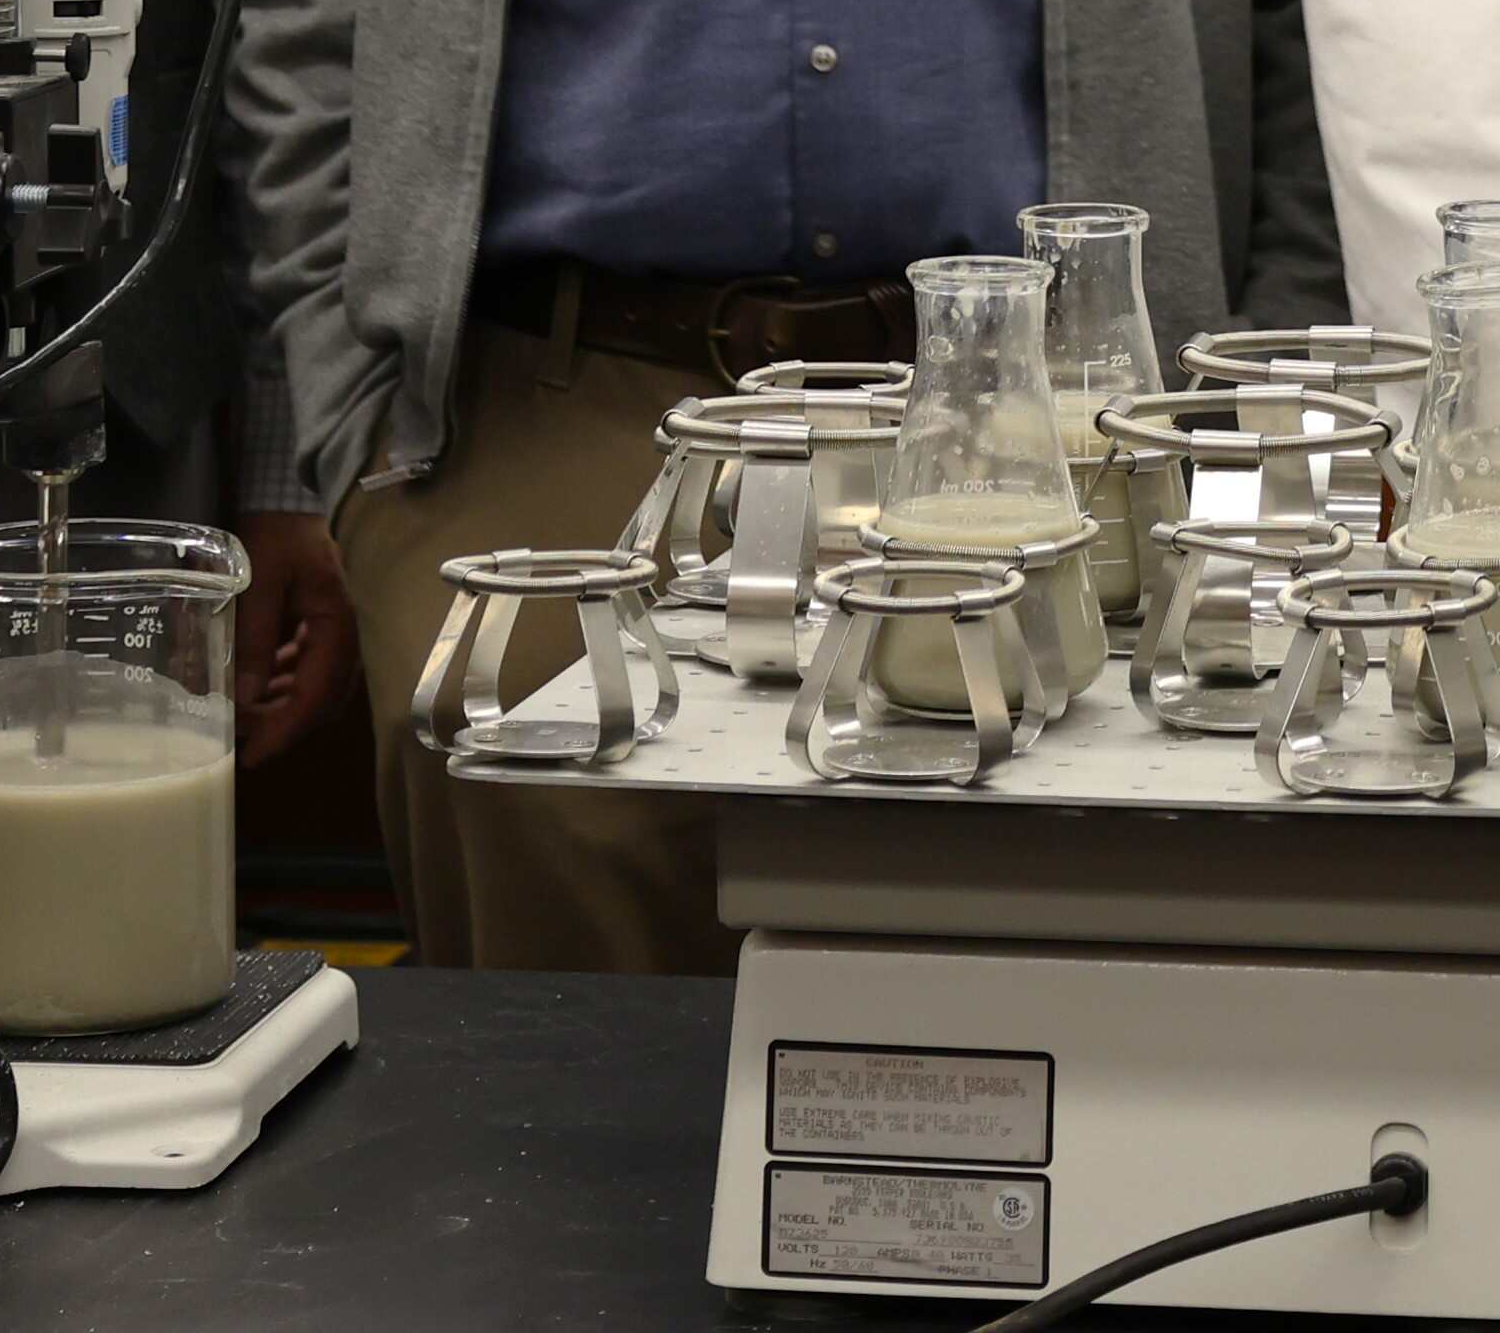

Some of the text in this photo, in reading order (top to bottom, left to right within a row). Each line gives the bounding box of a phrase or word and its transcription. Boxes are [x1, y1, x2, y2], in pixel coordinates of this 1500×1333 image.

[1110, 353, 1133, 368] 225
[778, 1214, 819, 1225] MODEL
[909, 1220, 958, 1231] SERIAL
[777, 1243, 819, 1254] VOLTS
[951, 1251, 993, 1262] WATTS
[810, 1258, 827, 1269] Hz
